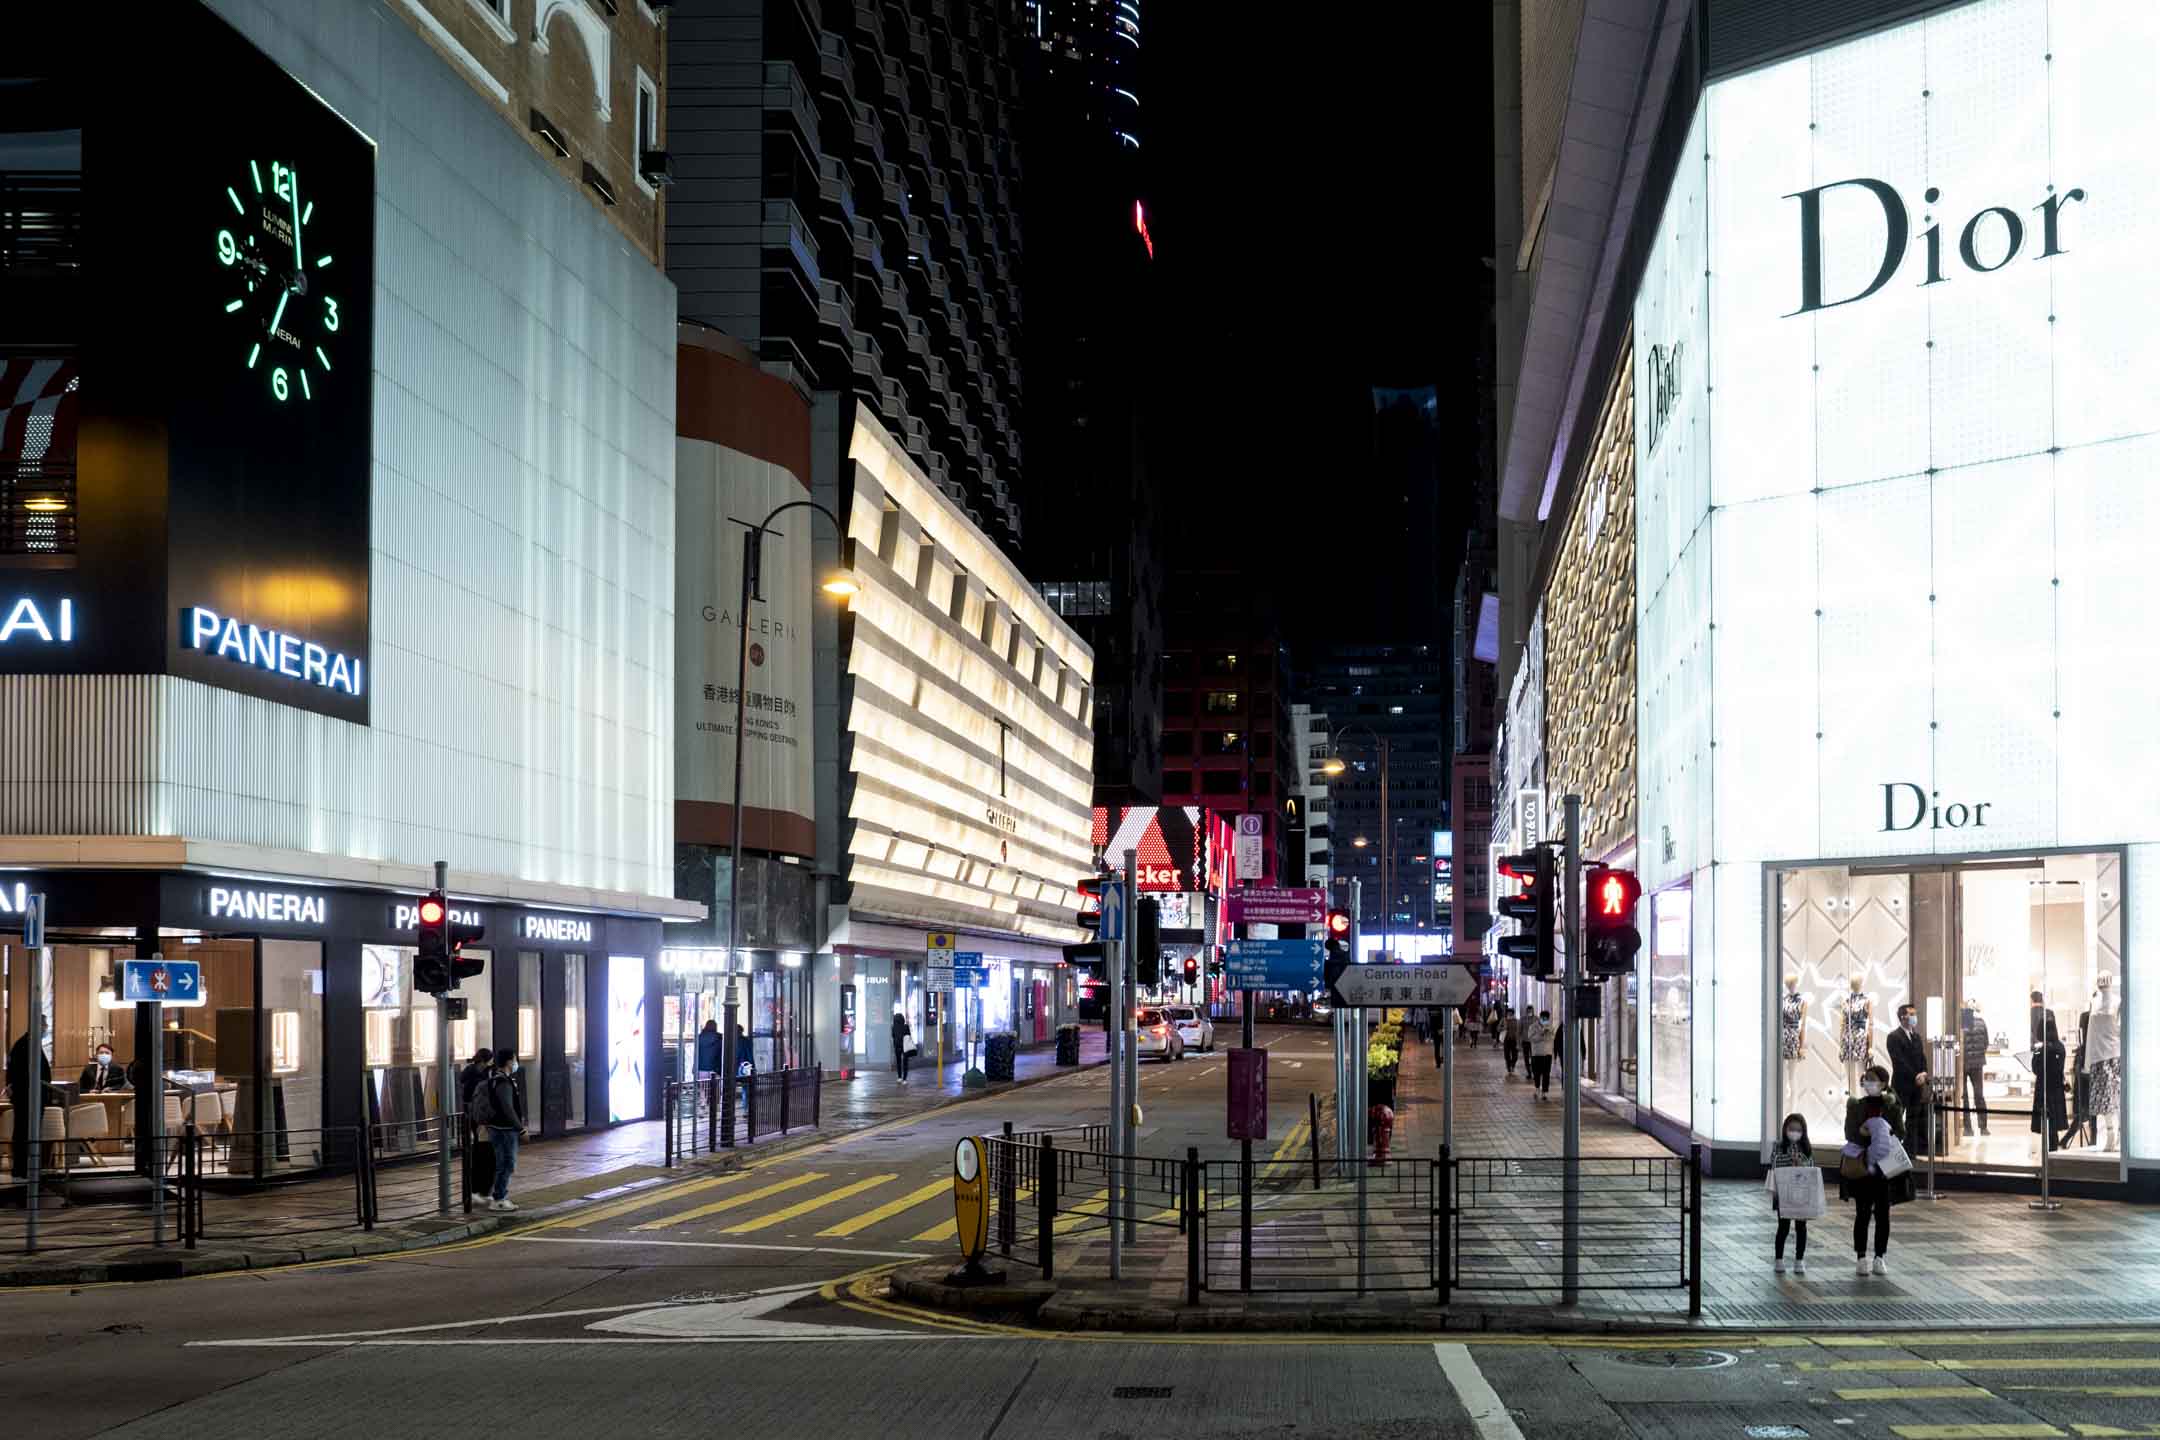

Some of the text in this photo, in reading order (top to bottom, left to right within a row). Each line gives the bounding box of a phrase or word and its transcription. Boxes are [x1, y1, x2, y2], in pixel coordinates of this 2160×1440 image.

[272, 161, 292, 202] 12
[218, 229, 235, 265] 9
[263, 219, 294, 247] MARIN
[1780, 178, 2086, 318] Dior
[324, 296, 339, 331] 3
[272, 367, 289, 401] 6
[1647, 340, 1683, 459] Dior
[0, 598, 72, 641] AI
[193, 607, 361, 696] PANERAI
[1877, 782, 1992, 832] Dior
[1137, 864, 1182, 884] cker
[210, 888, 325, 923] PANERAI
[396, 905, 480, 930] PARAI
[526, 916, 591, 942] PANERAI
[1364, 968, 1448, 980] Canton Road
[1380, 986, 1433, 1001] 廣東道
